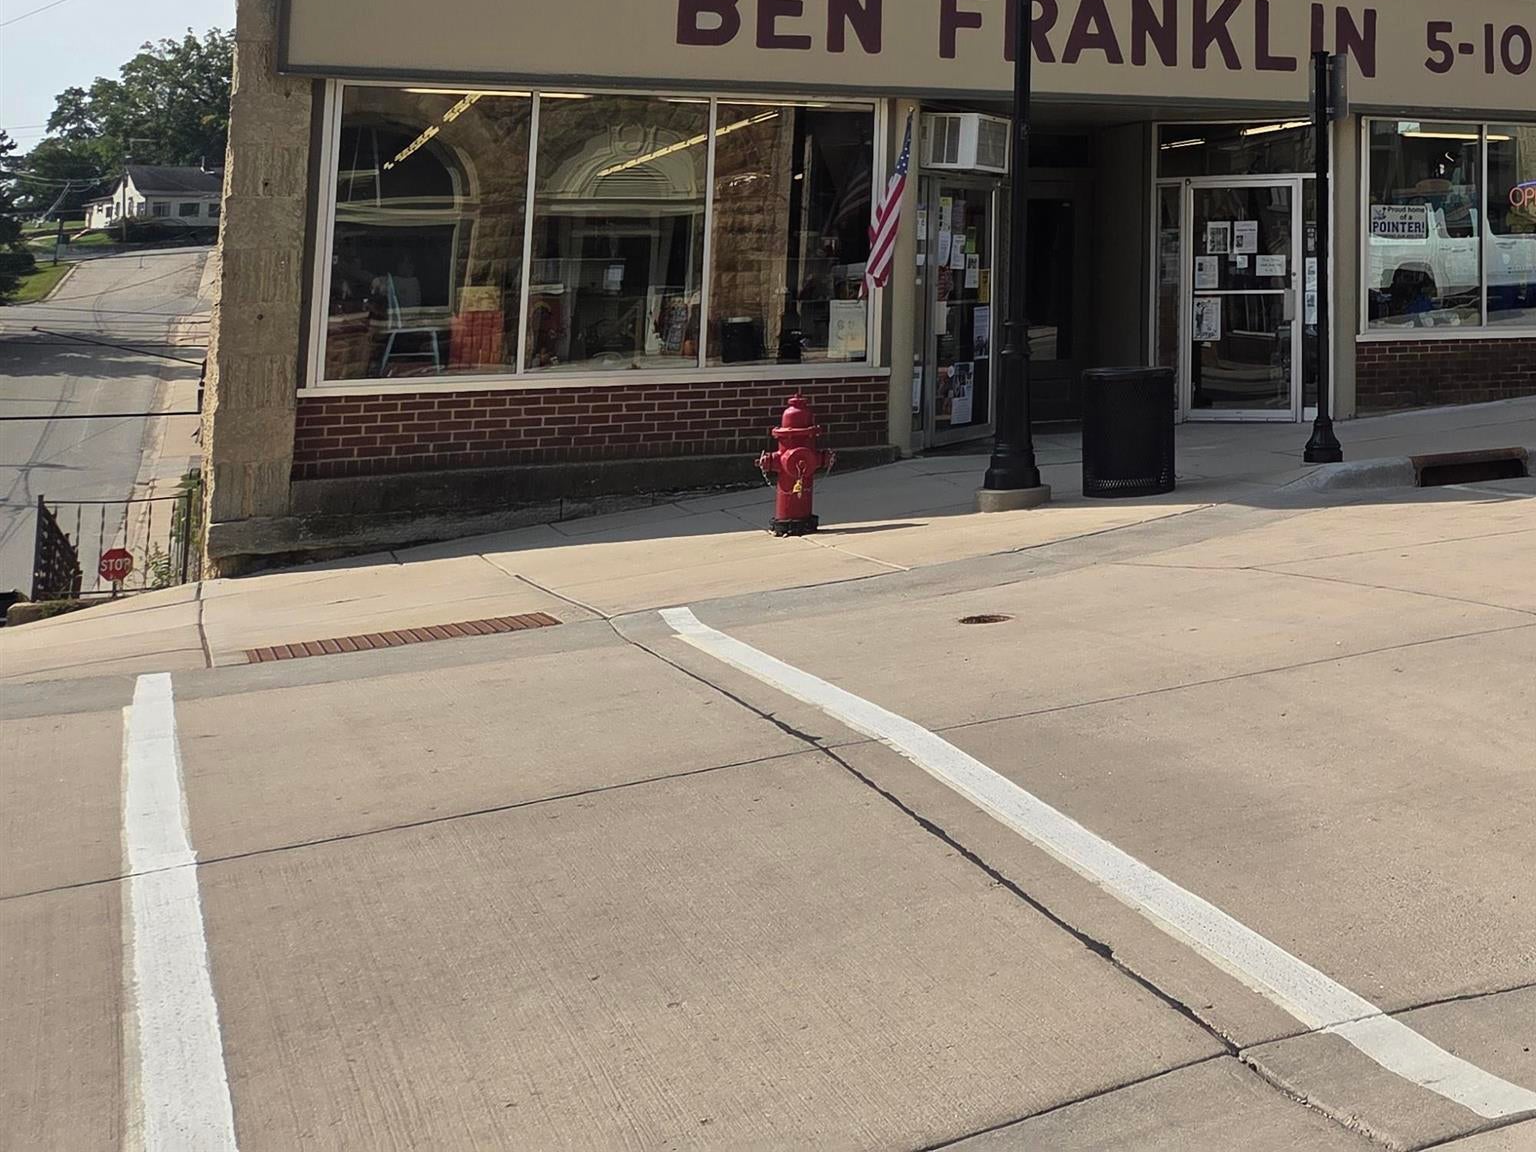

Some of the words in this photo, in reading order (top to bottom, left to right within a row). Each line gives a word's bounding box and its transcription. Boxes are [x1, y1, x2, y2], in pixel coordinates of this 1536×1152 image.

[1424, 20, 1533, 75] 5-10
[1372, 221, 1425, 233] POINTER!
[101, 558, 131, 571] STOP
